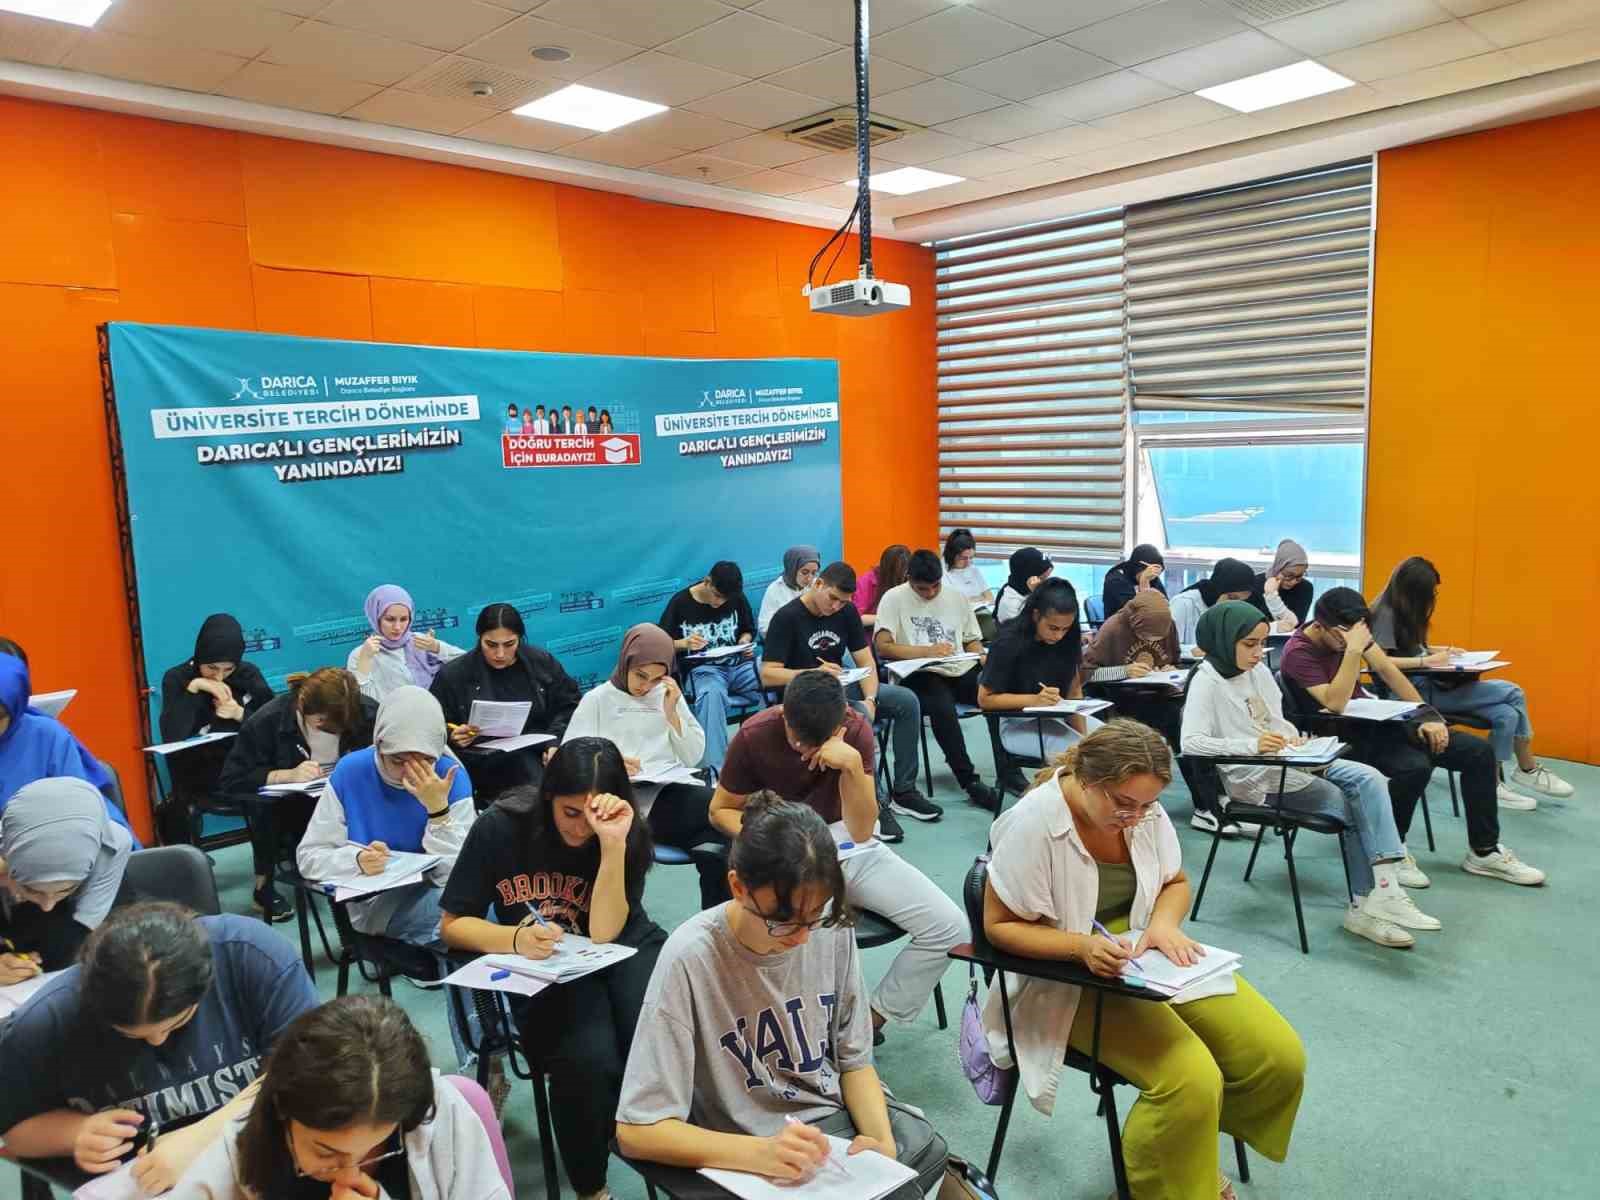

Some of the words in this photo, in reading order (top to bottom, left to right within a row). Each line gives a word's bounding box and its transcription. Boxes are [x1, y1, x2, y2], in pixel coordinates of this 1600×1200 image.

[261, 376, 317, 389] DARICA
[335, 376, 390, 386] MUZAFFER
[167, 409, 289, 431] ÜNİVERSİTE
[293, 404, 360, 424] TERCİH
[366, 400, 469, 421] DÖNEMİNDE
[663, 414, 729, 432] ÜNİVERSİTE
[732, 411, 770, 425] TERCİH
[772, 405, 832, 422] DÖNEMİNDE
[308, 427, 460, 455] GENÇLERİMİZİN
[509, 435, 552, 449] DOĞRU
[553, 436, 594, 449] TERCİH
[739, 428, 826, 449] GENÇLERİMİZİN
[274, 455, 401, 481] YANINDAYIZ!
[510, 450, 533, 466] İÇİN
[535, 452, 596, 463] BURADAYIZ!
[720, 449, 792, 468] YANINDAYIZ!
